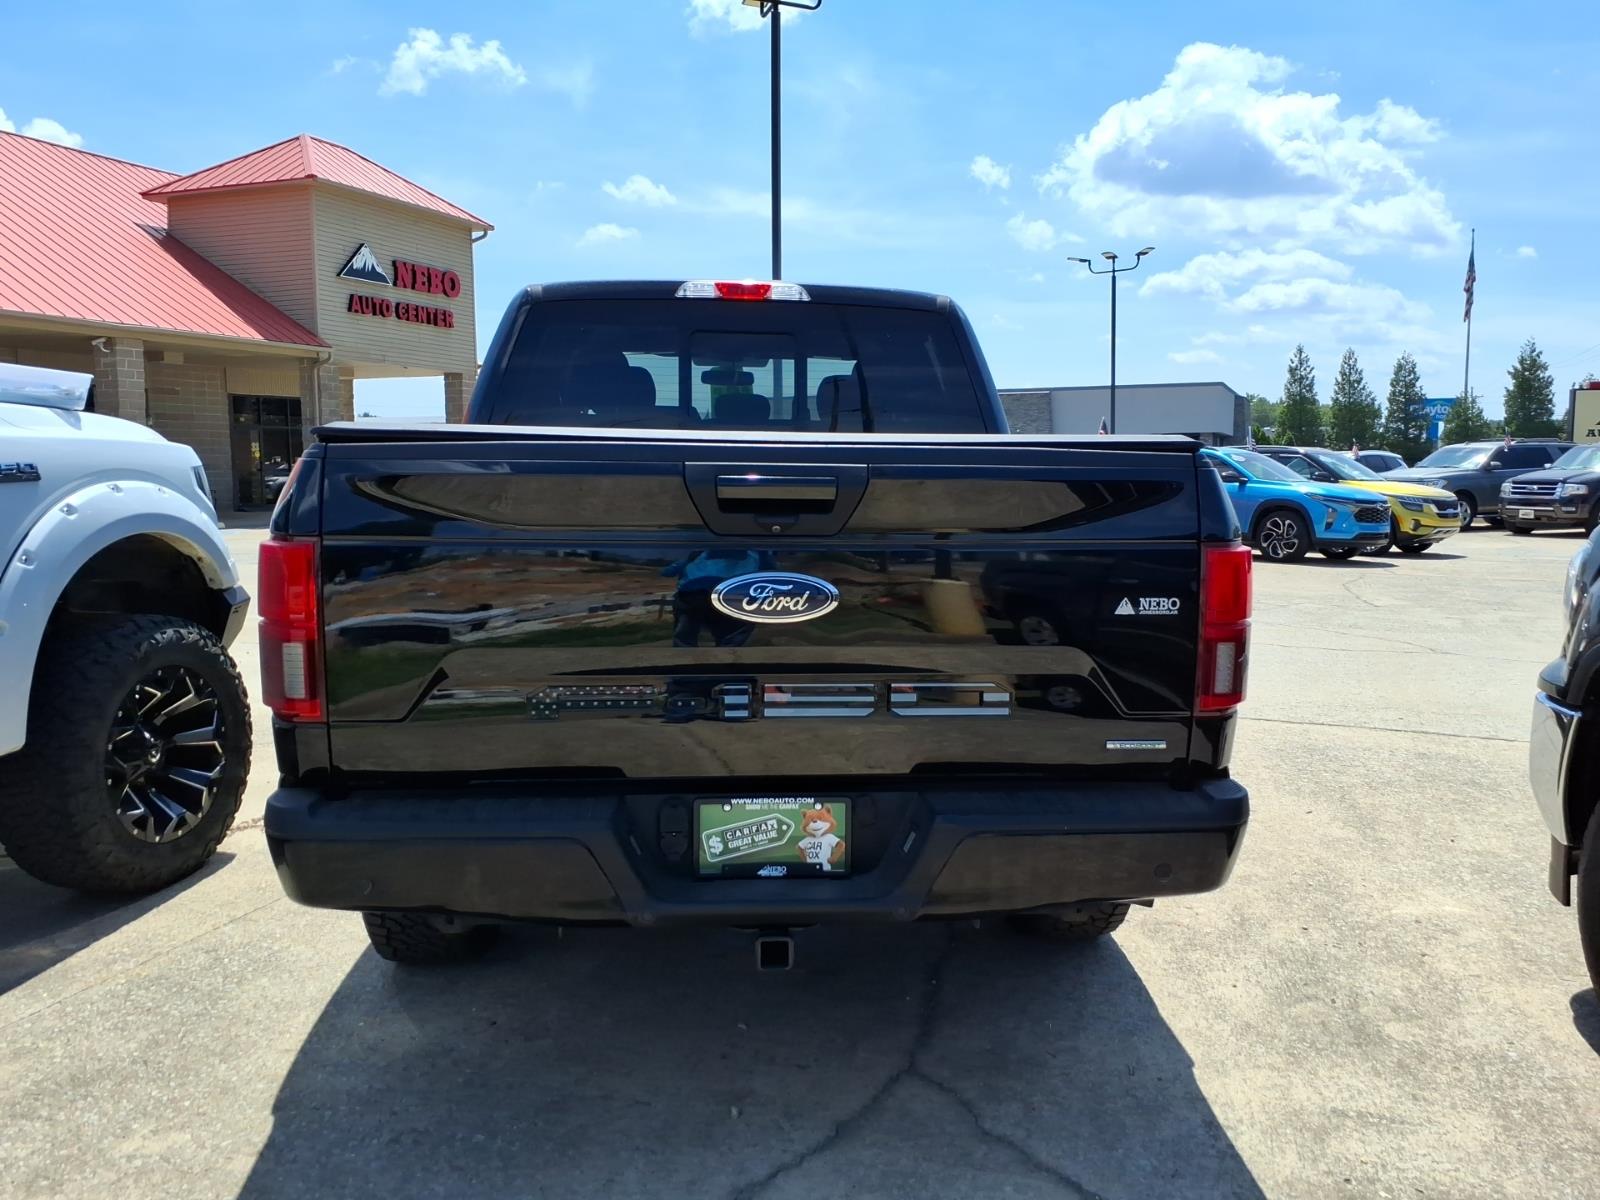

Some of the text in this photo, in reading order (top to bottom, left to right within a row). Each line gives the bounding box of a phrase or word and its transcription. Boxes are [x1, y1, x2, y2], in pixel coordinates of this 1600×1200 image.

[393, 259, 461, 299] NEBO
[348, 294, 454, 328] AUTO CENTER
[742, 583, 810, 611] Ford
[1139, 597, 1180, 610] NEBO
[725, 819, 778, 840] CARFAX
[728, 836, 752, 849] GREAT
[753, 830, 778, 842] VALUE
